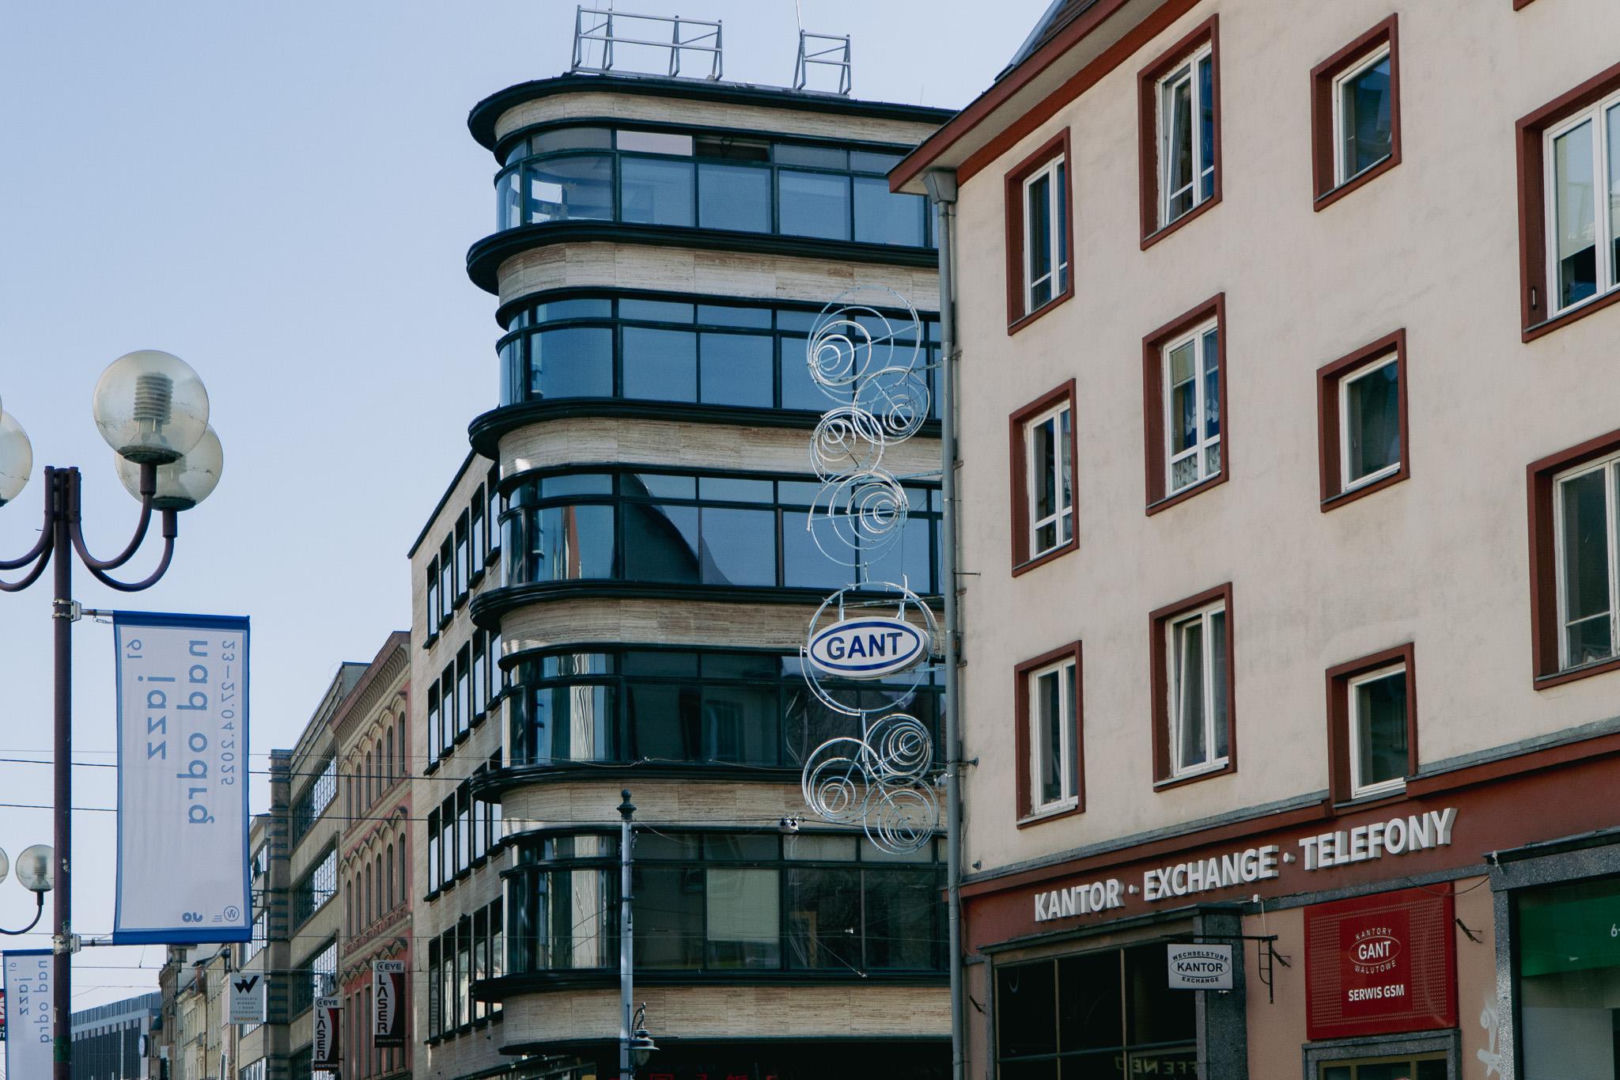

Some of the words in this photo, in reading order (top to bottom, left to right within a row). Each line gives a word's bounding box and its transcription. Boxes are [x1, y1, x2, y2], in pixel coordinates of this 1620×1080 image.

[826, 632, 903, 660] GANT
[1034, 878, 1123, 922] KANTOR
[1143, 845, 1279, 902] EXCHANGE
[1298, 807, 1458, 871] TELEFONY
[1355, 928, 1393, 940] KANTORY
[1358, 941, 1391, 960] GANT
[384, 963, 402, 971] EYE
[1177, 962, 1223, 972] KANTOR
[1354, 960, 1397, 974] WALUTOWE
[1181, 976, 1219, 984] EXCHANGE
[1348, 986, 1382, 1002] SERWIS
[1384, 984, 1405, 998] GSM
[377, 974, 389, 1033] LASER
[316, 1009, 327, 1059] LASER
